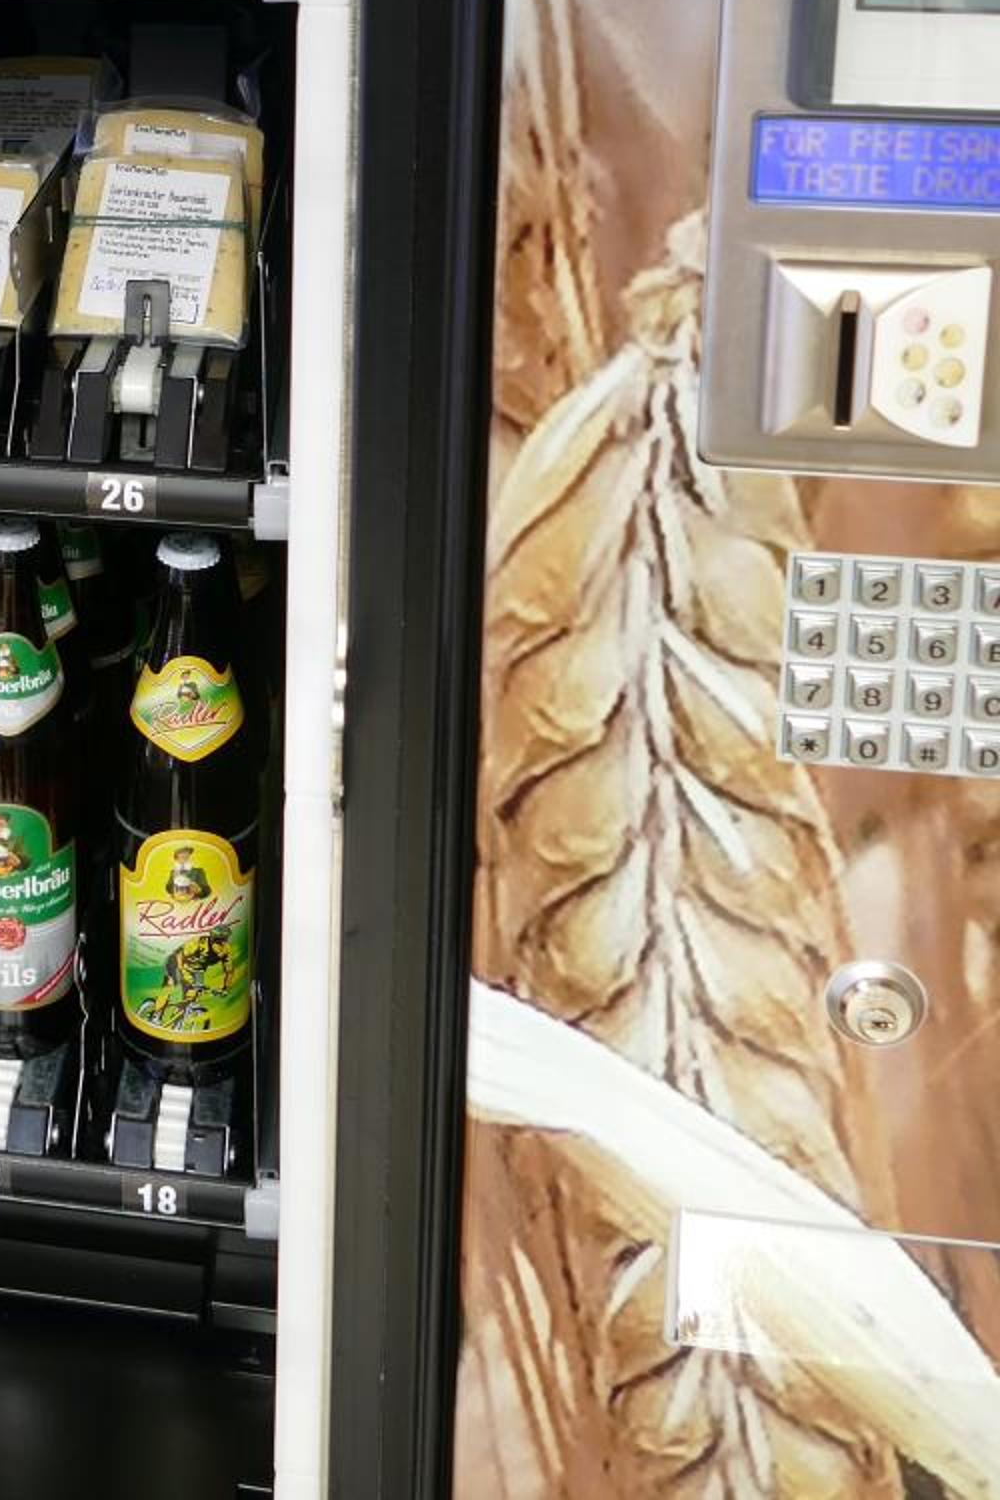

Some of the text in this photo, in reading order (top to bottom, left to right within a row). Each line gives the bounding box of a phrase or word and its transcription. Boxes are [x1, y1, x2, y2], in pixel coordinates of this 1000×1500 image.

[784, 161, 889, 196] TASTE
[100, 480, 144, 513] 26
[815, 578, 826, 597] 1
[871, 581, 889, 602] 2
[932, 585, 950, 605] 3
[807, 631, 825, 650] 4
[867, 635, 885, 655] 5
[929, 639, 947, 659] 6
[803, 683, 821, 703] 7
[863, 687, 881, 707] 8
[924, 691, 942, 711] 9
[152, 699, 228, 735] Radler
[859, 739, 878, 759] 0
[979, 749, 999, 768] D
[137, 896, 246, 938] Radler
[138, 1180, 176, 1214] 18
